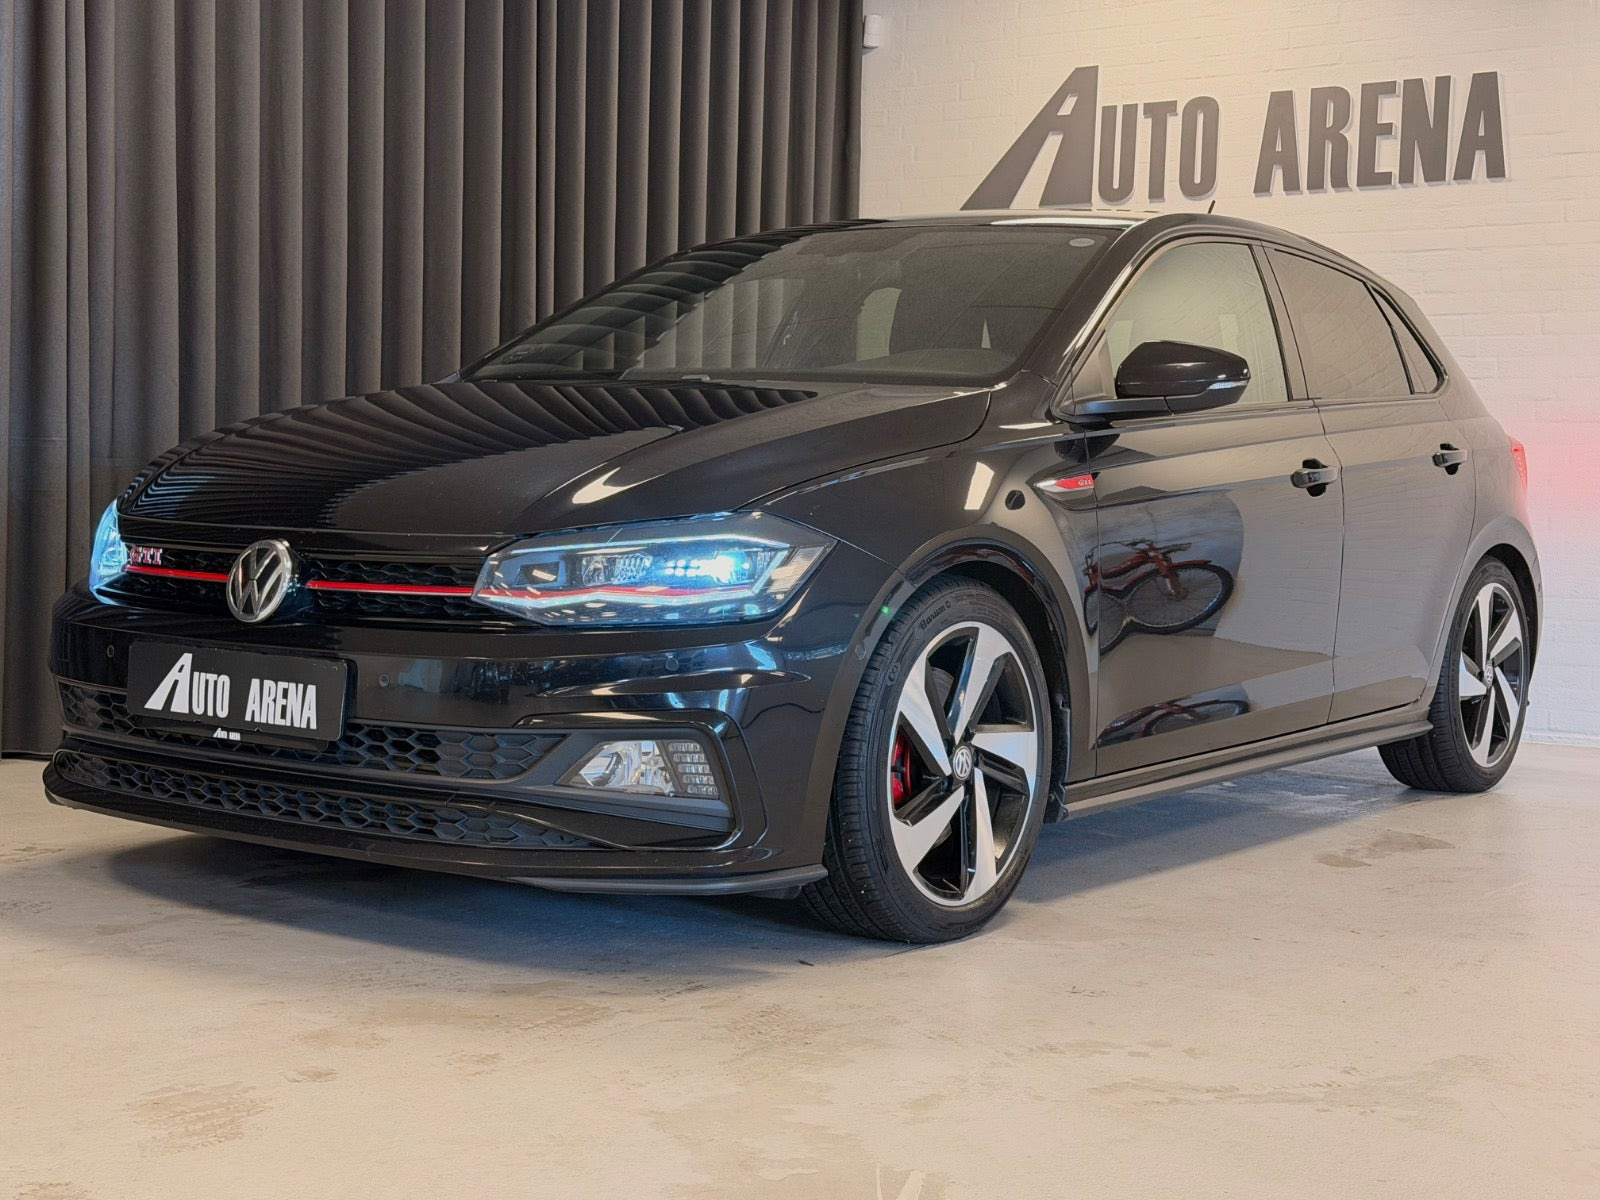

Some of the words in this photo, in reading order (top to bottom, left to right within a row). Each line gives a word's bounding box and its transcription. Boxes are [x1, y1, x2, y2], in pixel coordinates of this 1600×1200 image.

[960, 65, 1220, 209] AUTO
[1252, 71, 1507, 197] ARENA
[130, 546, 163, 566] GTI
[143, 652, 231, 719] AUTO
[244, 678, 317, 730] ARENA
